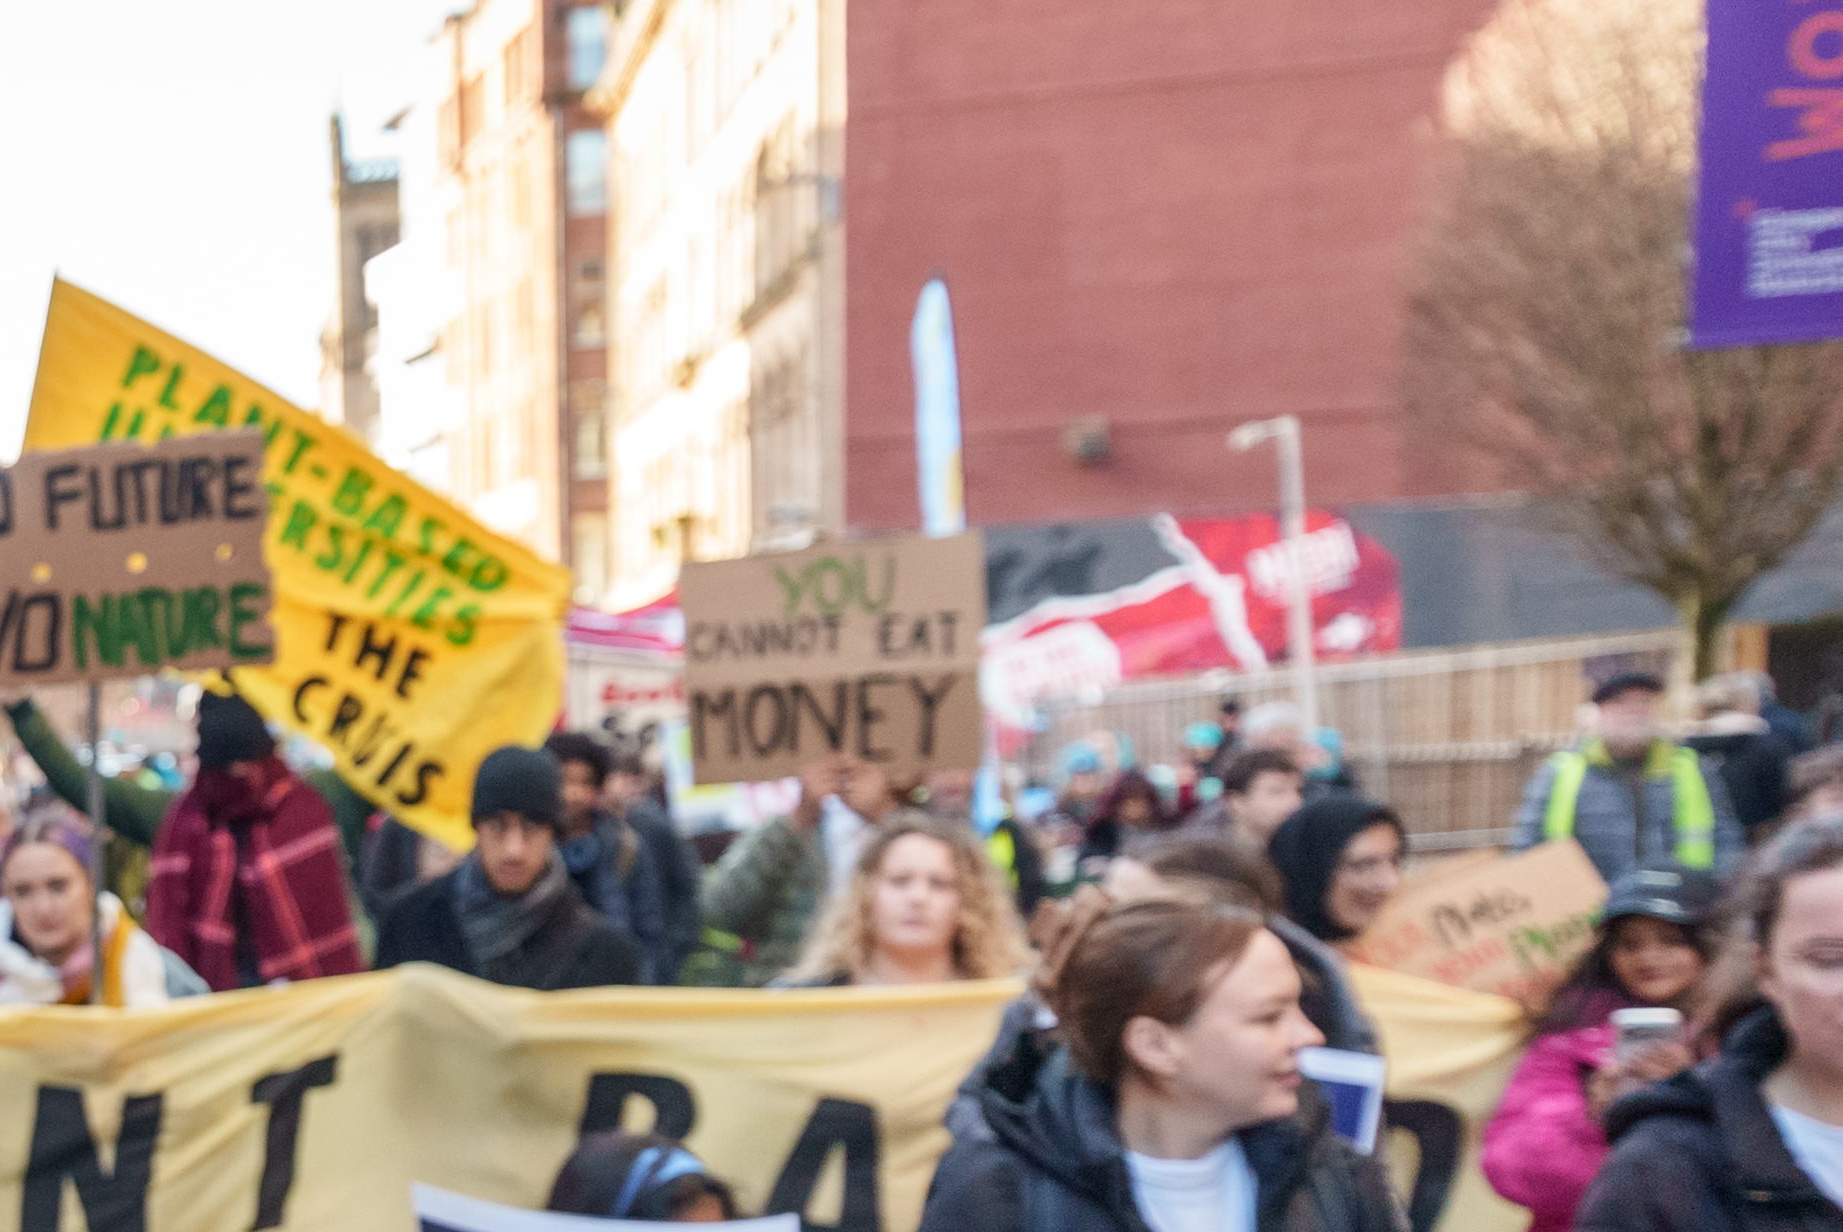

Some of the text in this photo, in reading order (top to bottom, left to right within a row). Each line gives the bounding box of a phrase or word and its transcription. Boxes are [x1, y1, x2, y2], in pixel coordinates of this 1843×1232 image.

[45, 455, 256, 531] FUTURE
[71, 582, 271, 670] NATURE
[773, 555, 896, 620] YOU
[325, 610, 433, 698] THE
[689, 608, 961, 662] CANNOT EAT
[690, 671, 962, 760] MONEY
